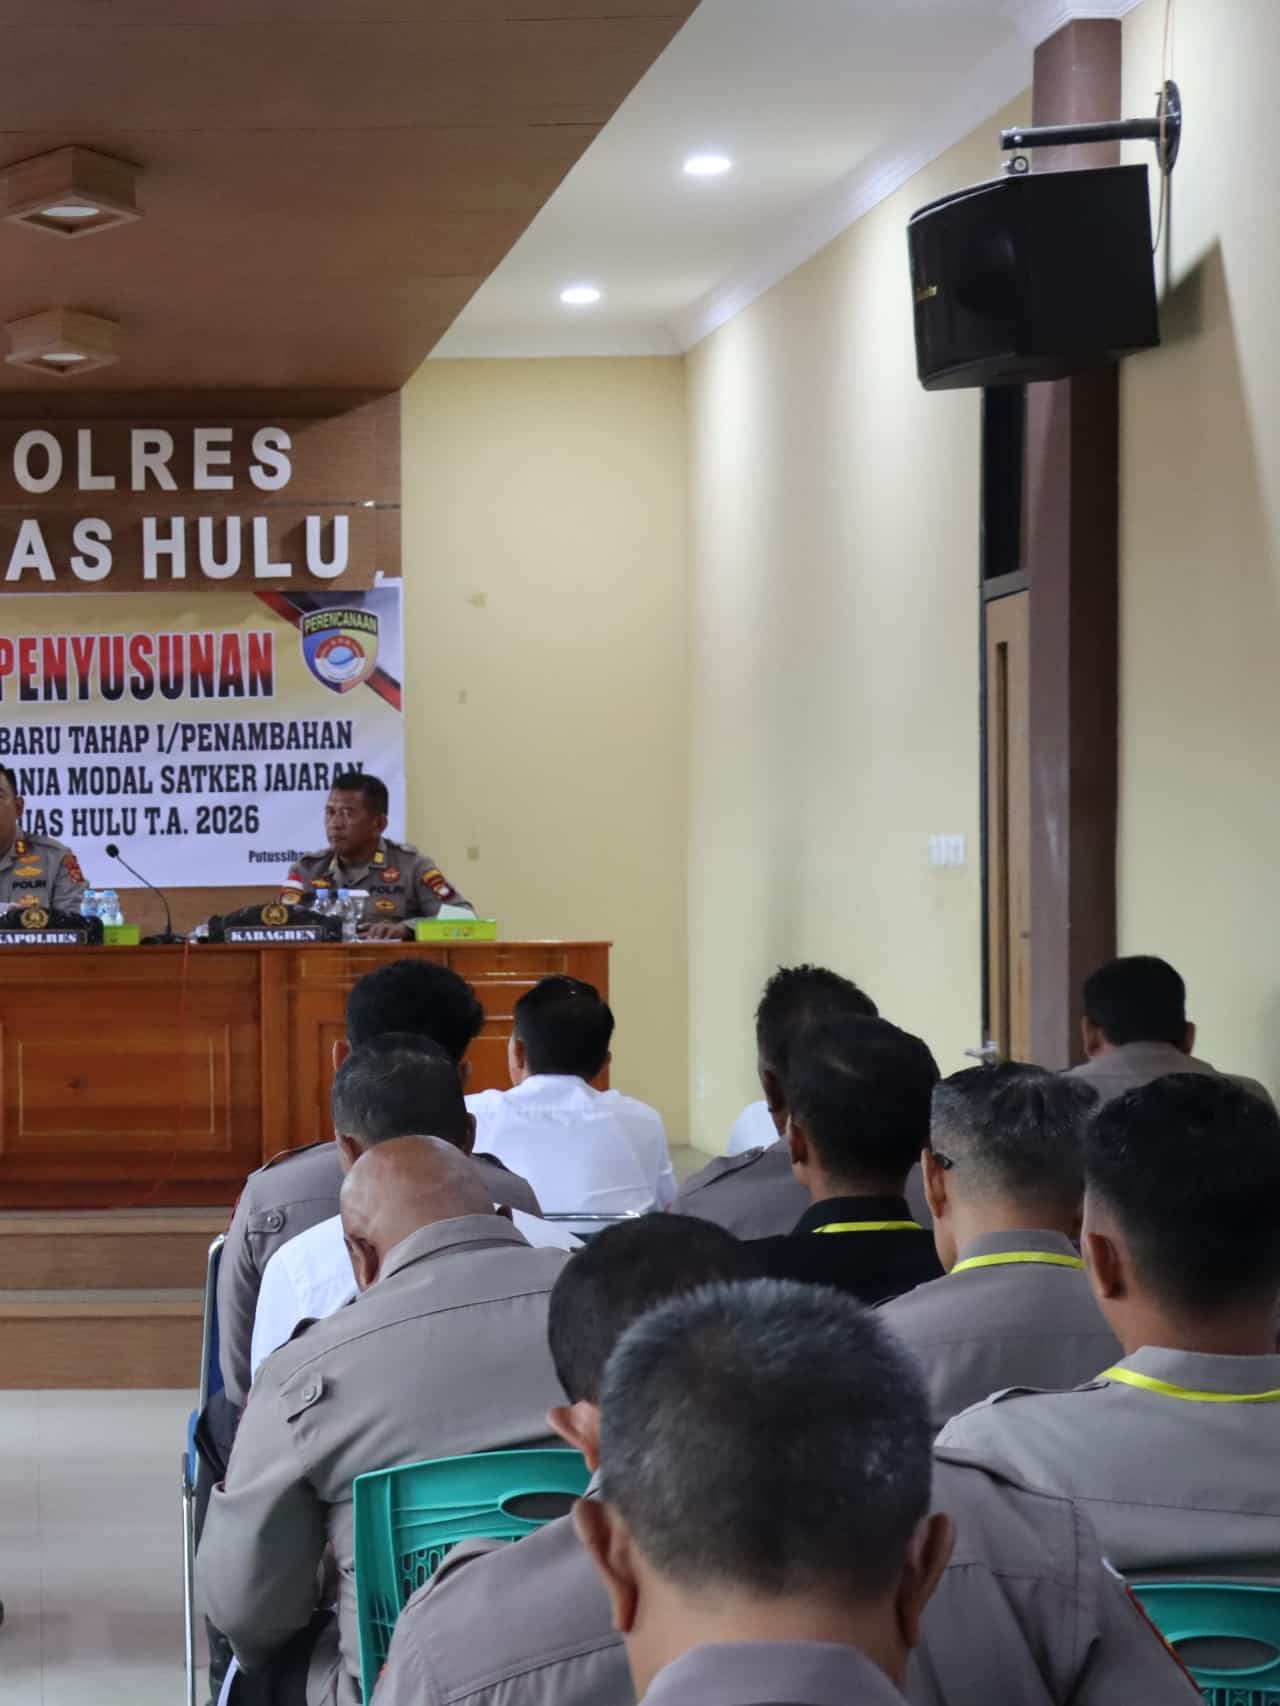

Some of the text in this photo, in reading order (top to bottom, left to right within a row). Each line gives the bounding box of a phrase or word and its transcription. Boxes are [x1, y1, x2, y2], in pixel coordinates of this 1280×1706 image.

[143, 514, 350, 579] HULU
[303, 611, 378, 634] PERENCANAAN
[68, 724, 150, 754] TAHAP
[156, 720, 353, 754] I/PENAMBAHAN
[67, 765, 154, 796] MODAL
[160, 763, 257, 795] SATKER
[71, 806, 137, 837] HULU
[144, 806, 189, 836] T.A.
[195, 804, 260, 834] 2026
[12, 880, 46, 889] POLRI
[370, 885, 405, 895] POLRI
[230, 930, 316, 942] KABAGREN
